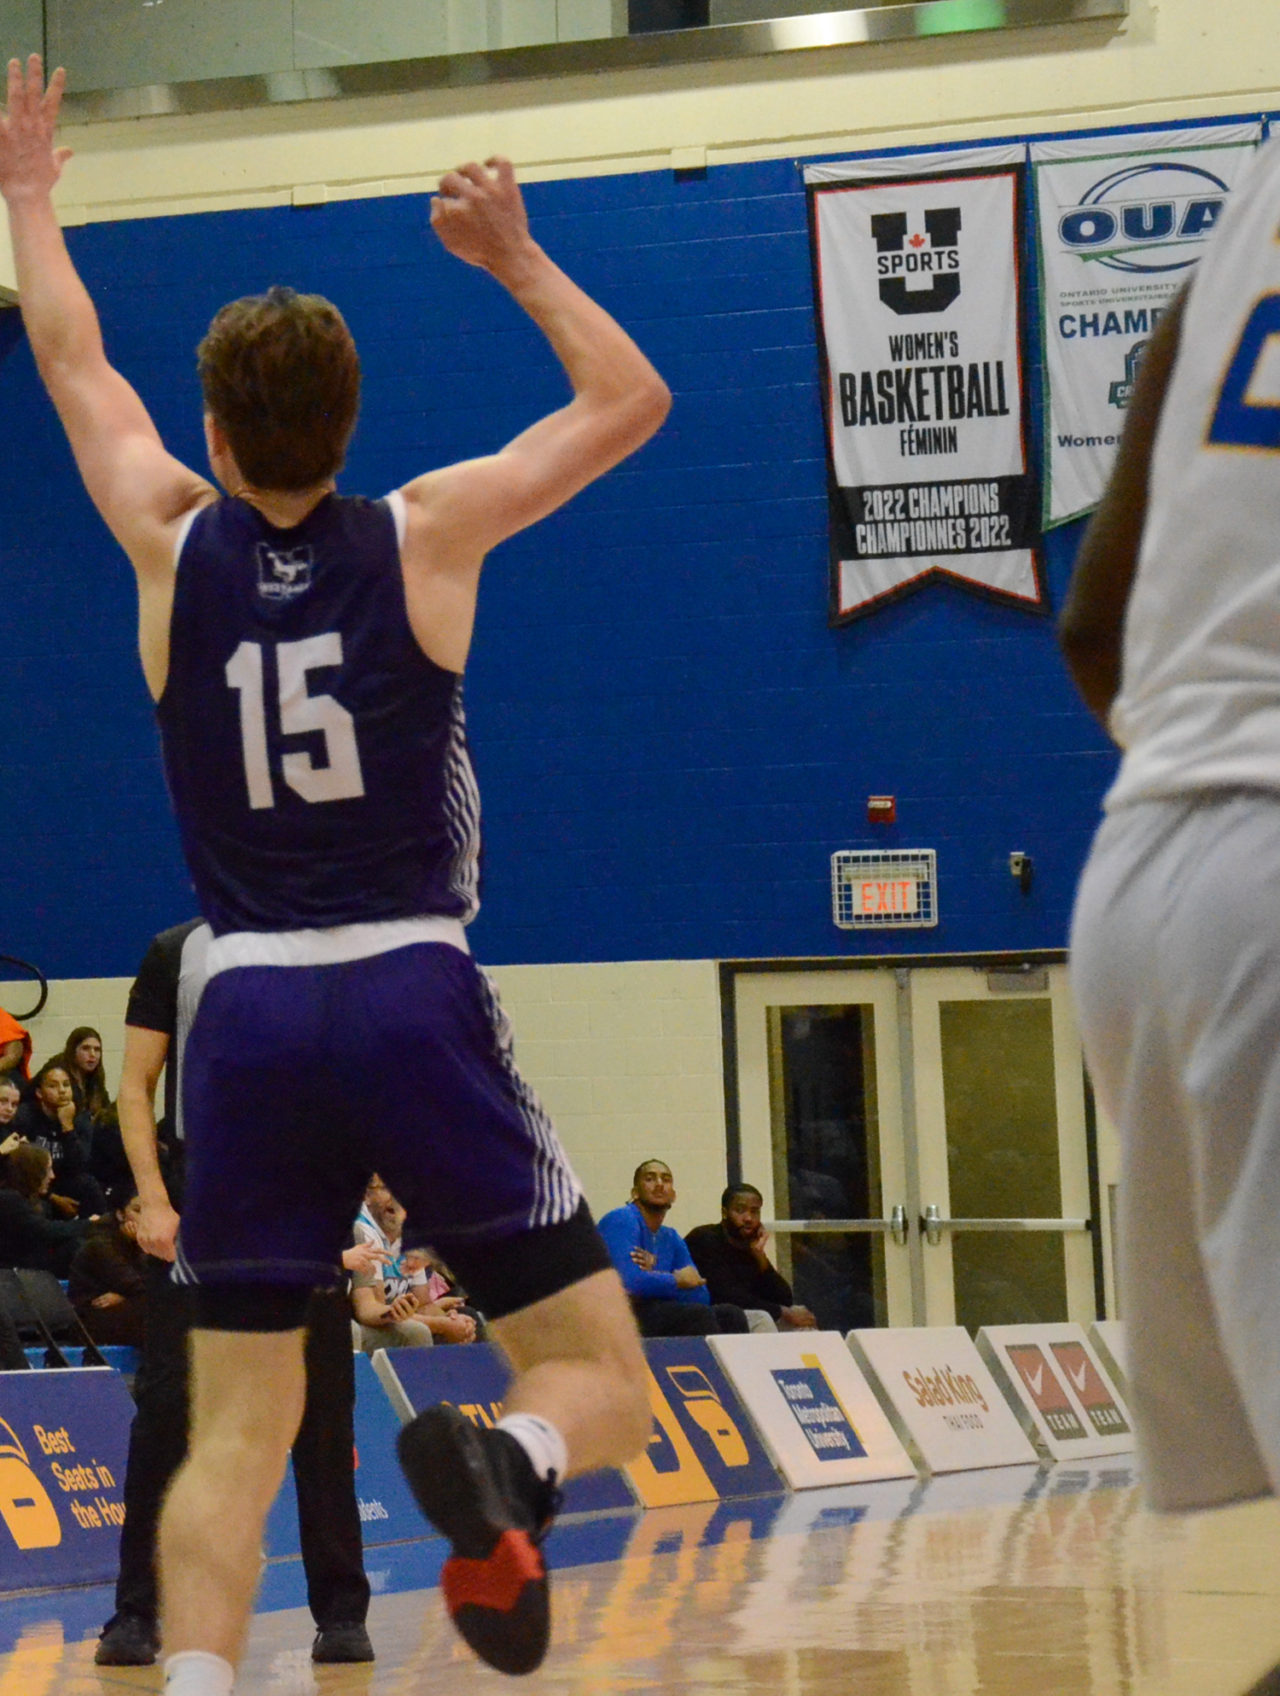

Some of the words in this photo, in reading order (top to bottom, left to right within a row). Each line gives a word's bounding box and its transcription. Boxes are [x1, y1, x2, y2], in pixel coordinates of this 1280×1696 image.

[877, 250, 960, 275] SPORTS
[1111, 282, 1179, 295] UNIVERSITY
[889, 331, 959, 362] WOMEN'S
[839, 360, 1010, 428] BASKETBALL
[900, 424, 958, 456] FÉMININ
[1057, 434, 1122, 448] Wome
[863, 489, 906, 521] 2022
[907, 481, 1000, 519] CHAMPIONS
[855, 518, 967, 555] CHAMPIONNES
[969, 514, 1012, 548] 2022
[225, 632, 365, 810] 15
[861, 881, 911, 912] EXIT
[1046, 1412, 1080, 1431] TEAM
[1090, 1409, 1122, 1427] TEAM
[33, 1424, 76, 1455] Best
[51, 1461, 99, 1492] Seats
[92, 1459, 116, 1488] in
[71, 1498, 102, 1529] the
